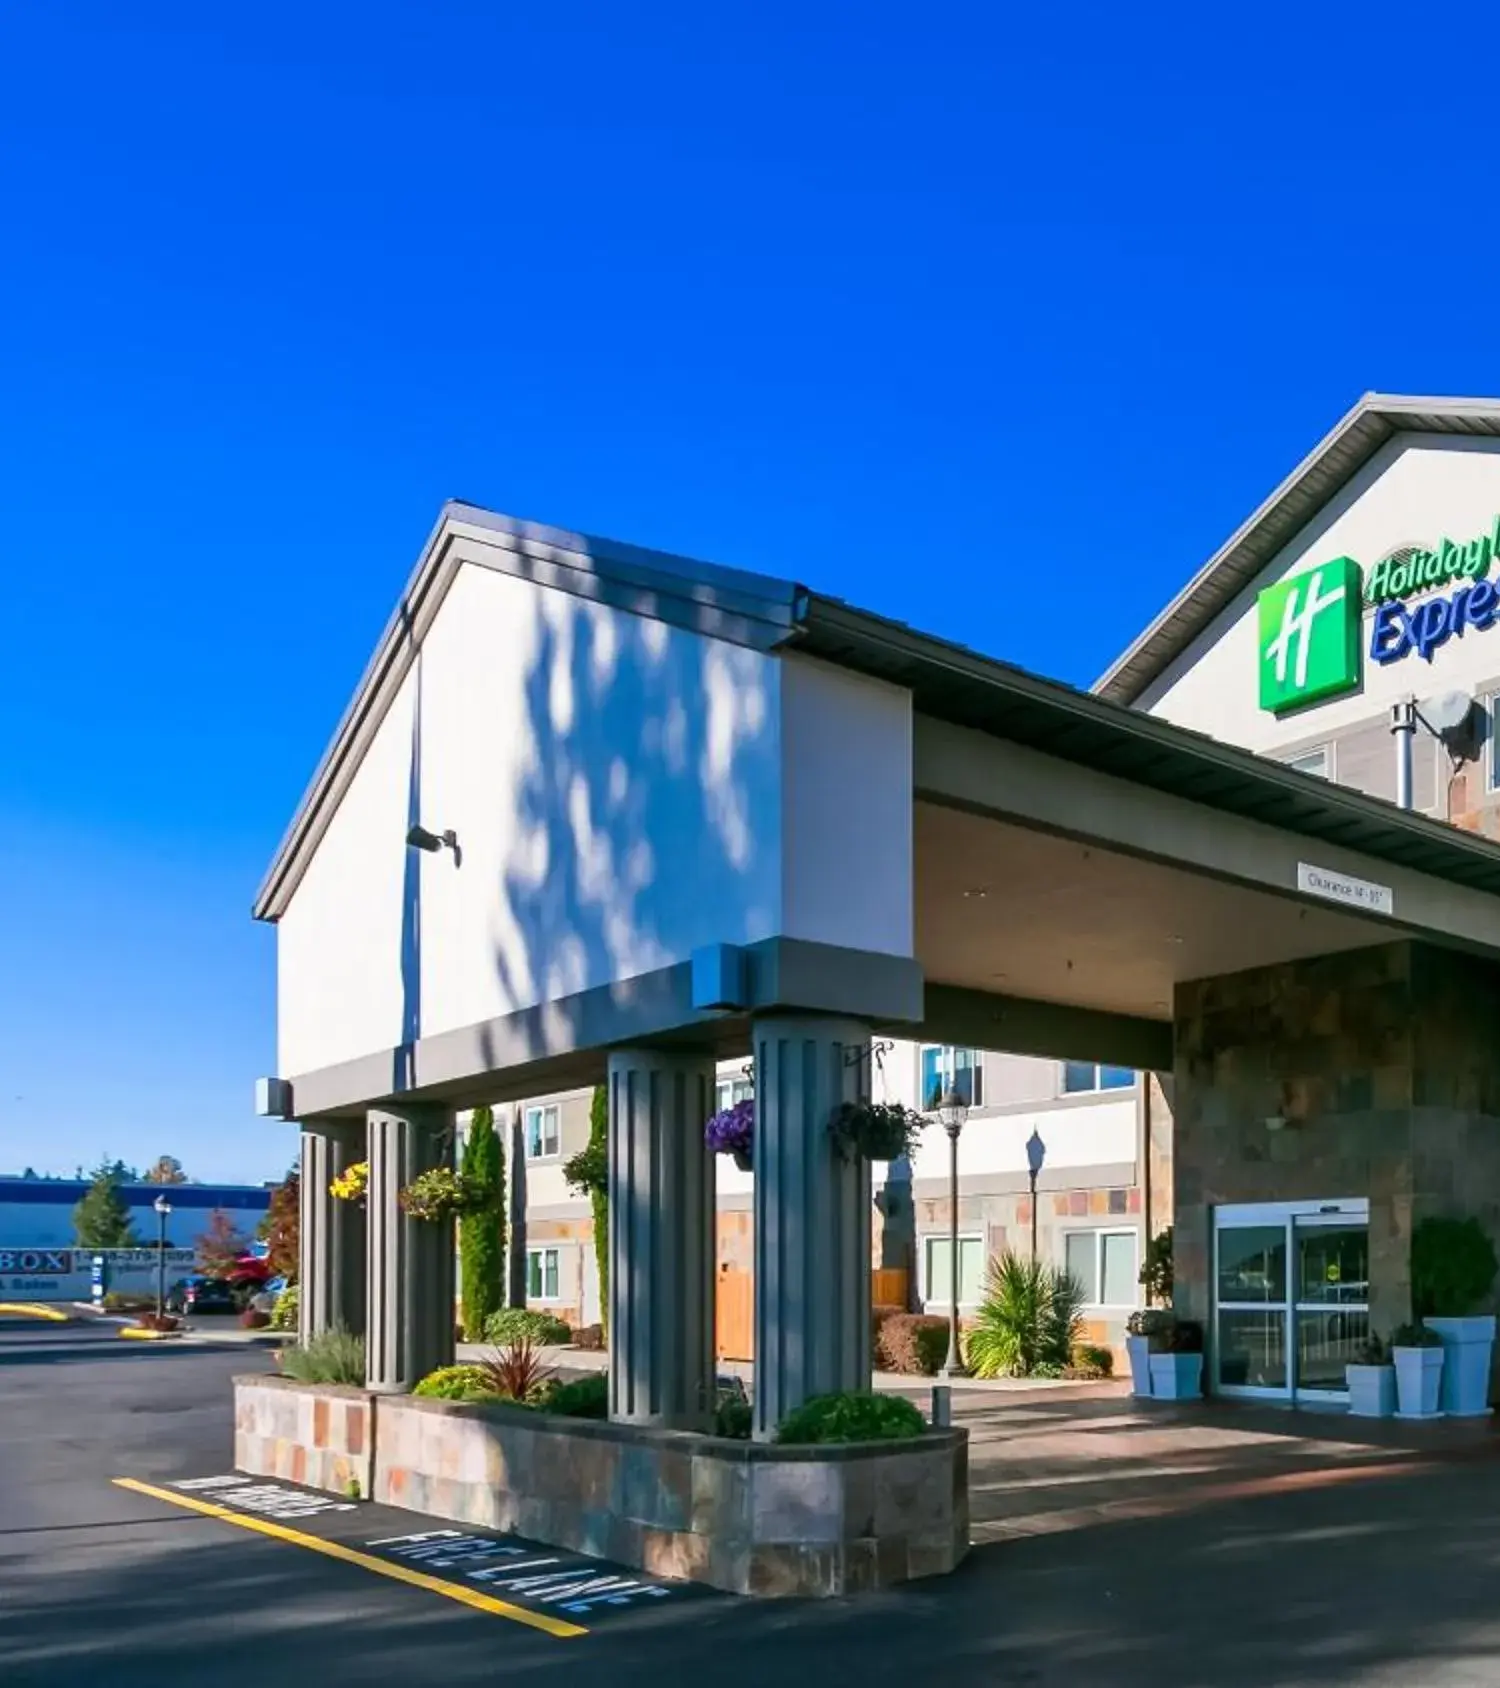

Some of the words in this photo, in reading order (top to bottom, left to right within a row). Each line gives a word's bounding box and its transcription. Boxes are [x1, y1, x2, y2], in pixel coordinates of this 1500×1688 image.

[1368, 537, 1491, 601] Holiday
[1265, 571, 1346, 688] H
[365, 1529, 526, 1567] FIRE
[466, 1557, 671, 1613] LANE
